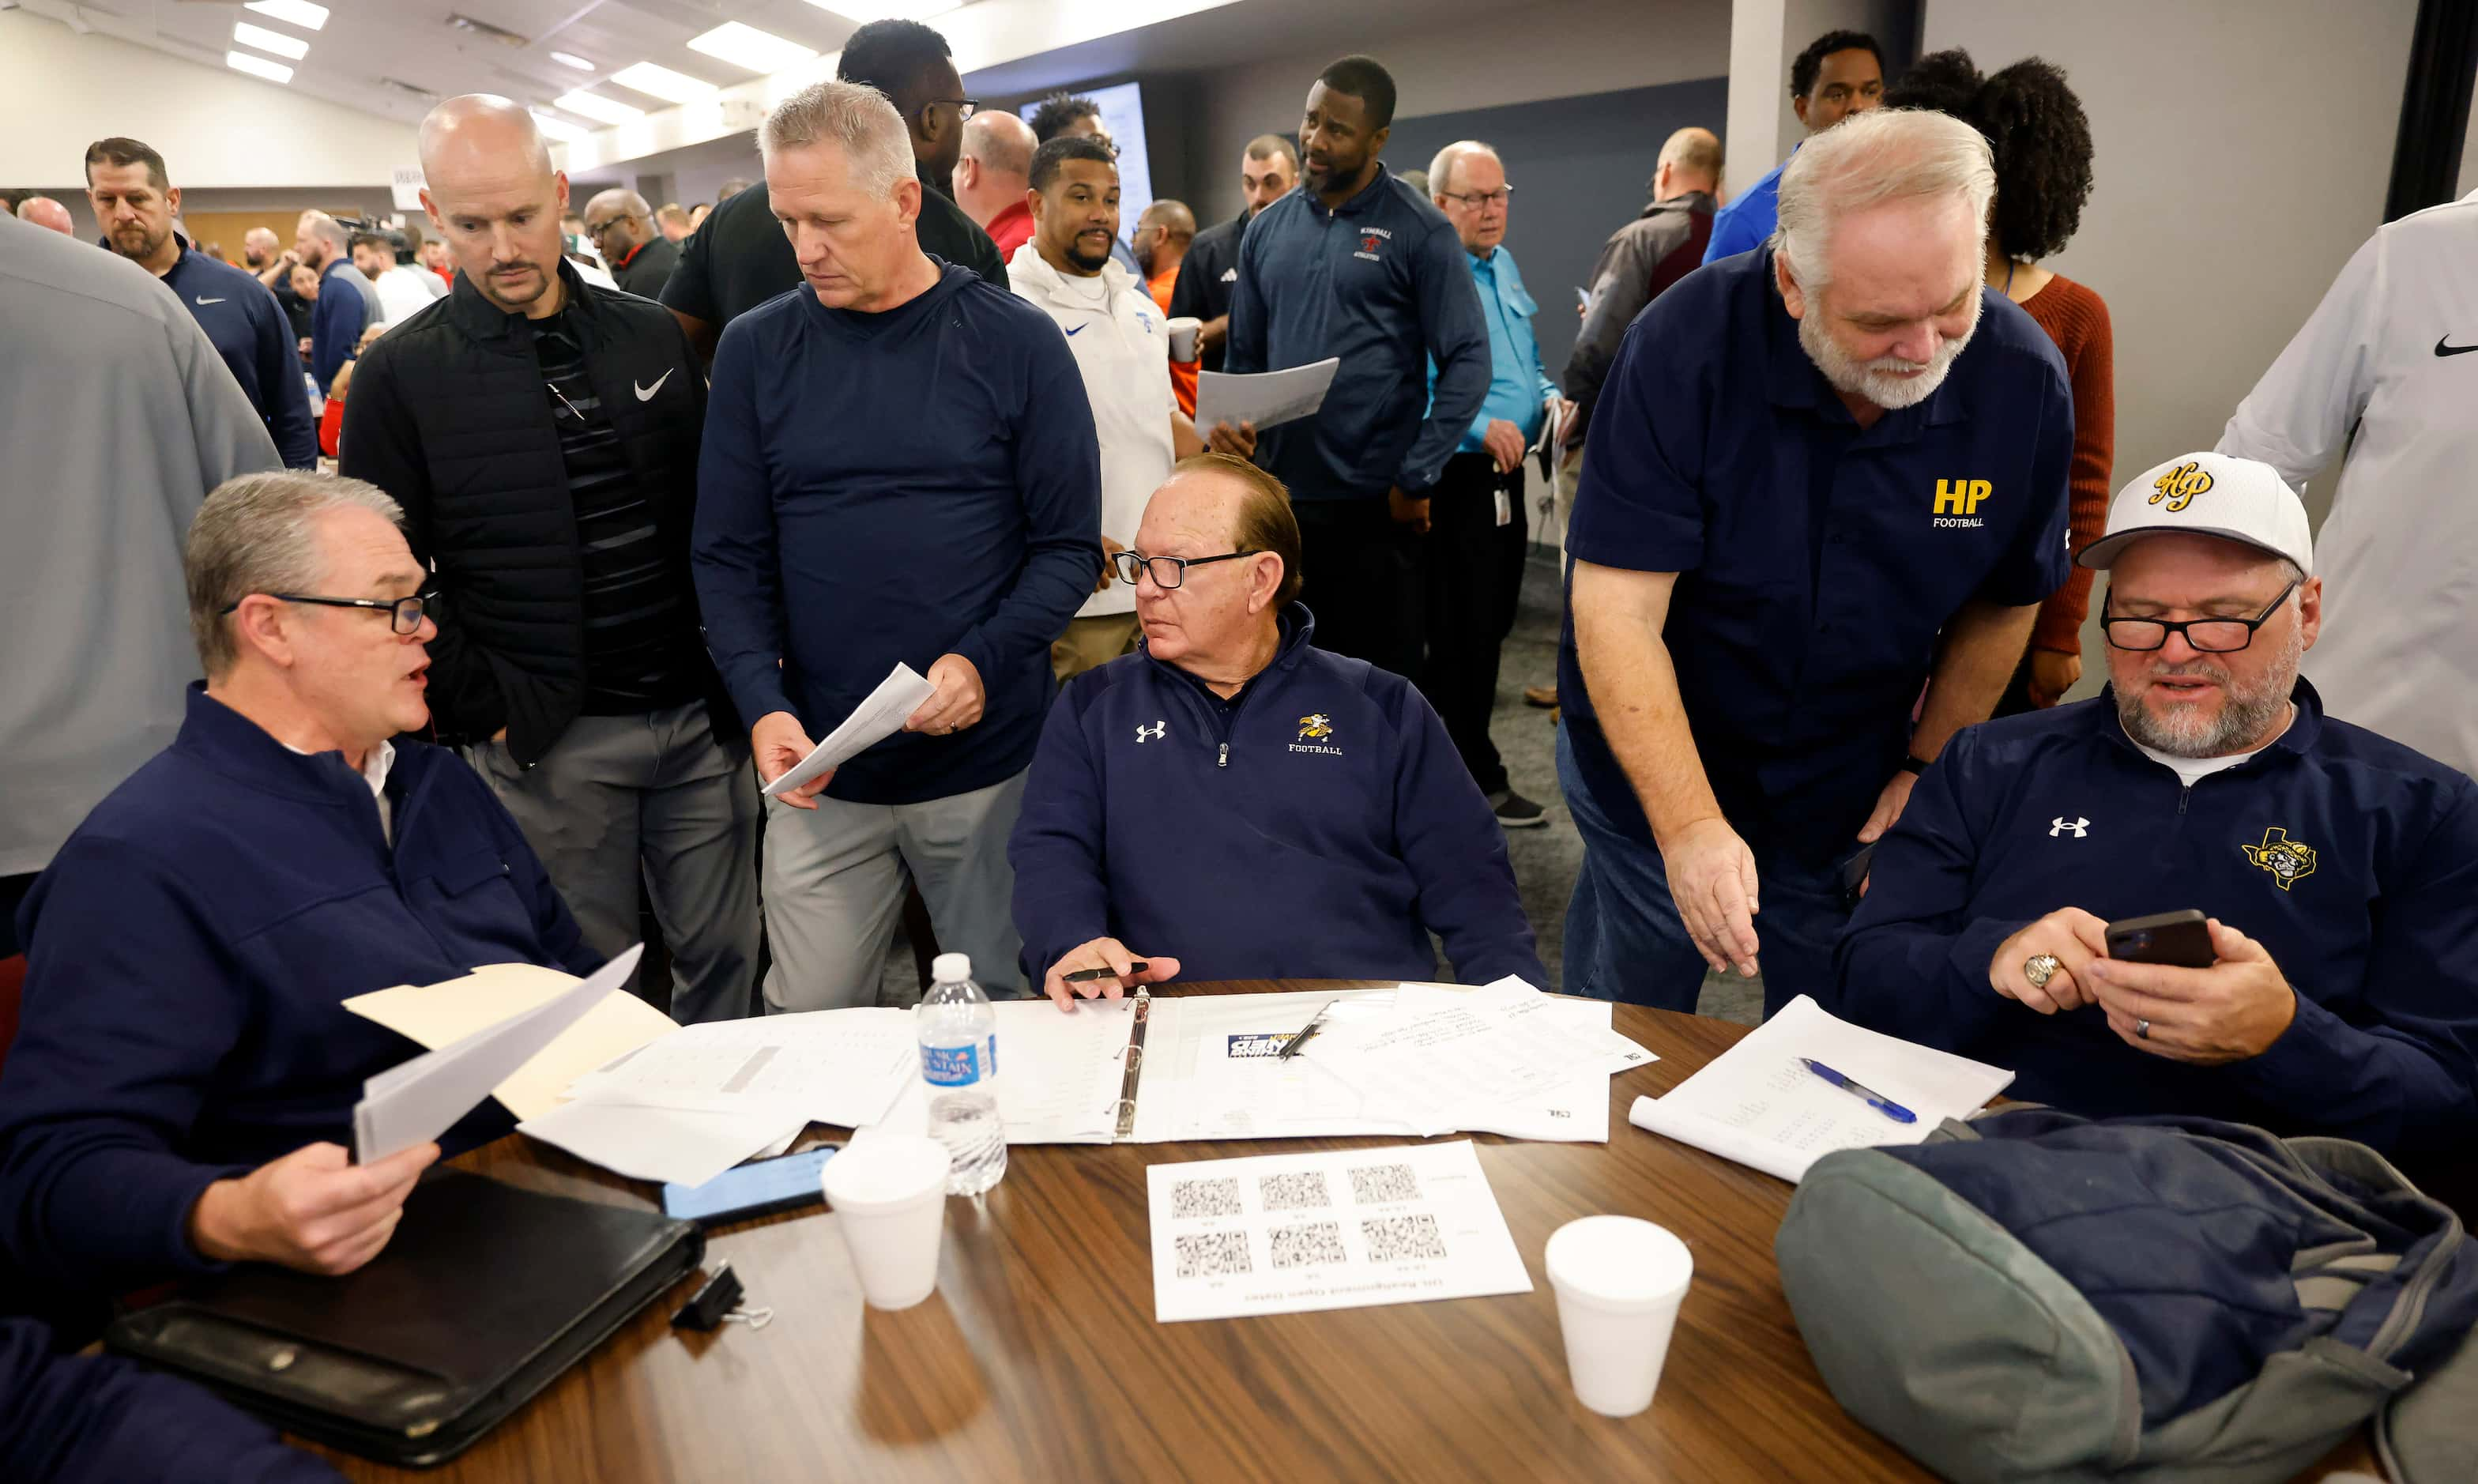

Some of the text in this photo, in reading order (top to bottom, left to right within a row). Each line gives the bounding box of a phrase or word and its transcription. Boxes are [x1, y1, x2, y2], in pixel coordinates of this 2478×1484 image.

[1360, 227, 1392, 239] KIMBALL
[1933, 479, 1993, 515] HP
[1933, 518, 1985, 529] FOOTBALL
[1288, 743, 1343, 756] FOOTBALL
